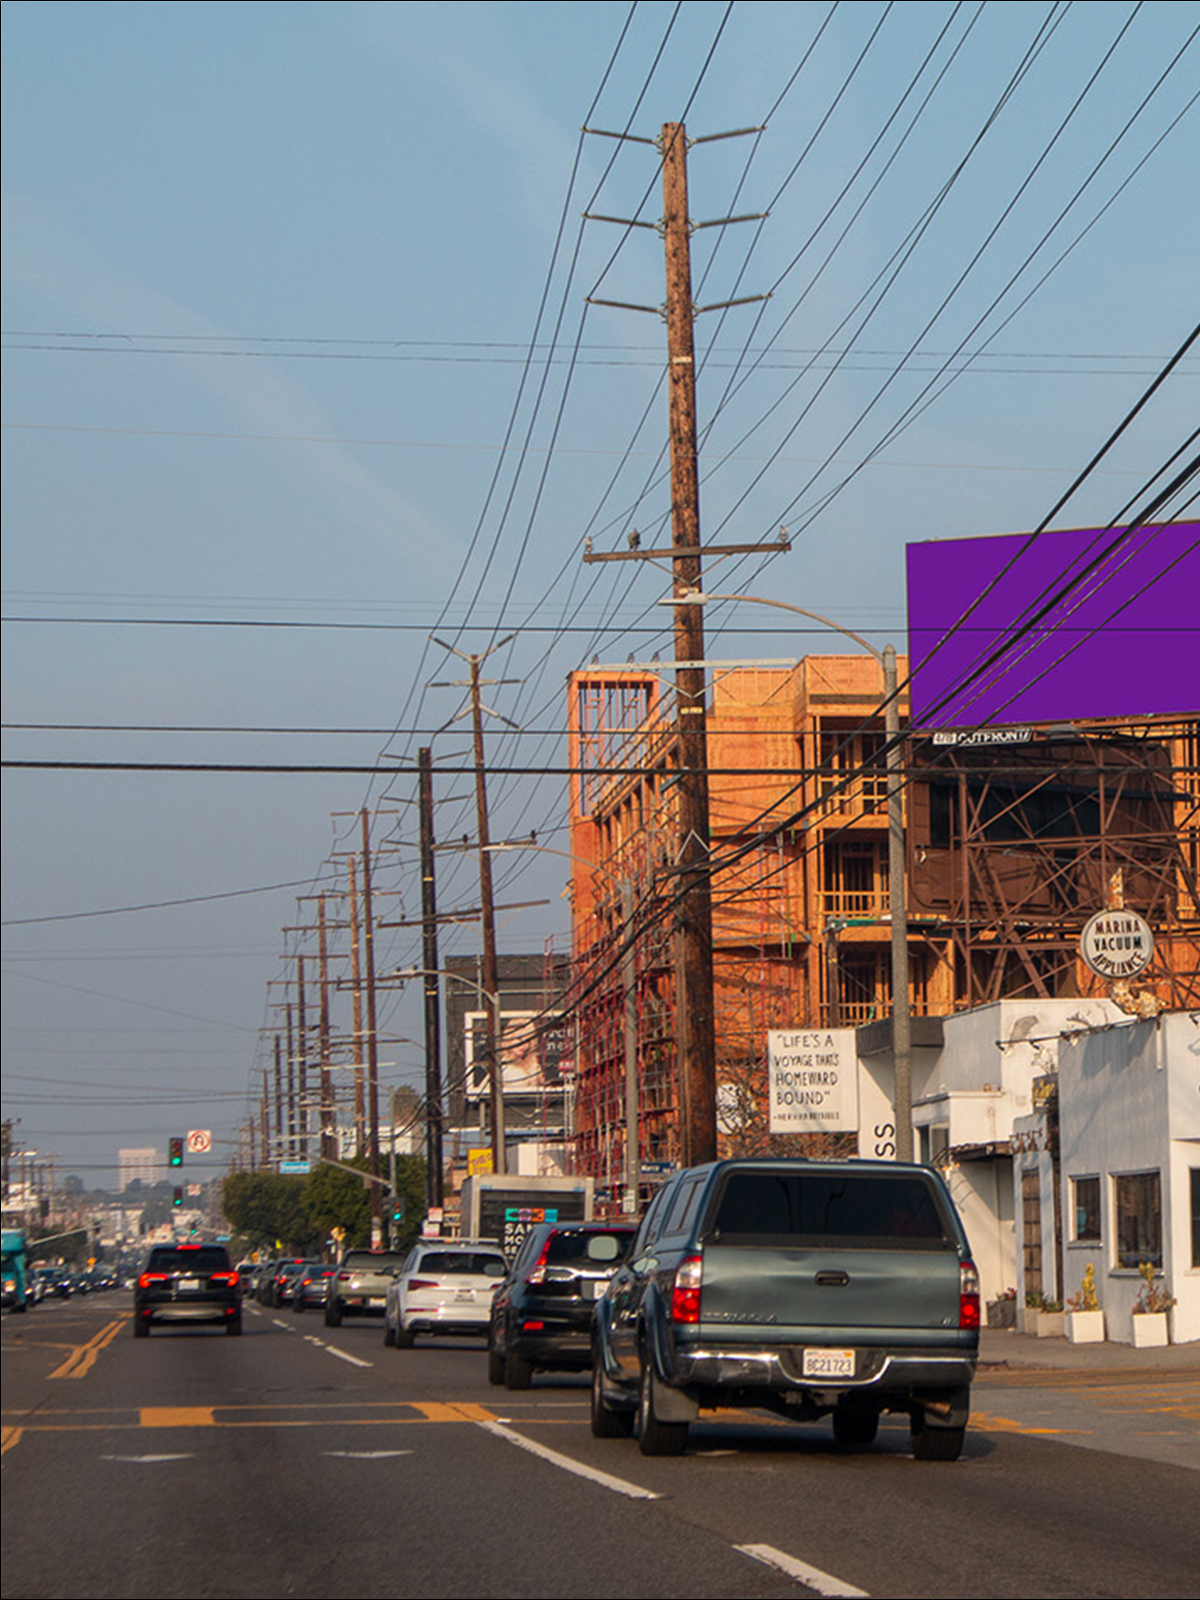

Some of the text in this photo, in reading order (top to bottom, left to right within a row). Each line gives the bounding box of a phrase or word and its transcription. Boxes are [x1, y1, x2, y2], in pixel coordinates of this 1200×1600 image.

[1095, 920, 1141, 934] MARINA
[1093, 936, 1143, 952] VACUUM
[1092, 951, 1146, 975] APPLIANCE
[825, 1034, 834, 1047] A
[774, 1053, 839, 1068] VOYAGE THAT'S
[776, 1071, 838, 1087] HOMEWARD
